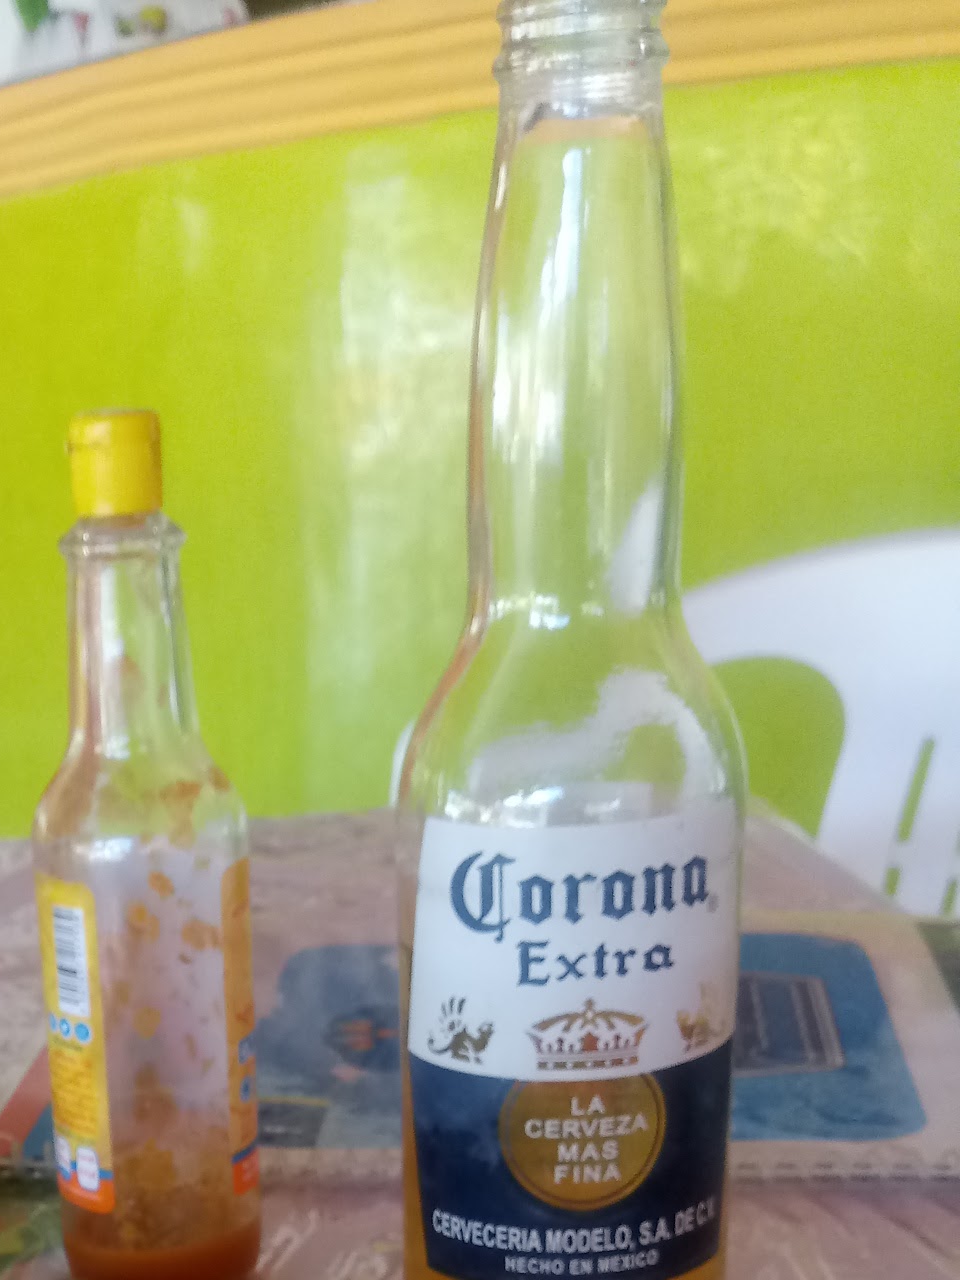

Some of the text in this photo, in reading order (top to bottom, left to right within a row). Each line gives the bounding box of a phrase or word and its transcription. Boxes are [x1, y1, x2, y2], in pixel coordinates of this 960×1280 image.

[449, 851, 710, 944] Corona
[516, 939, 675, 988] Extra
[570, 1094, 607, 1117] LA
[524, 1112, 649, 1140] CERVEZA
[556, 1139, 620, 1163] MAS
[553, 1161, 623, 1185] FINA
[431, 1207, 543, 1253] CERVECERIA
[674, 1205, 696, 1239] DE
[504, 1248, 660, 1277] HECHO EN MEXICO
